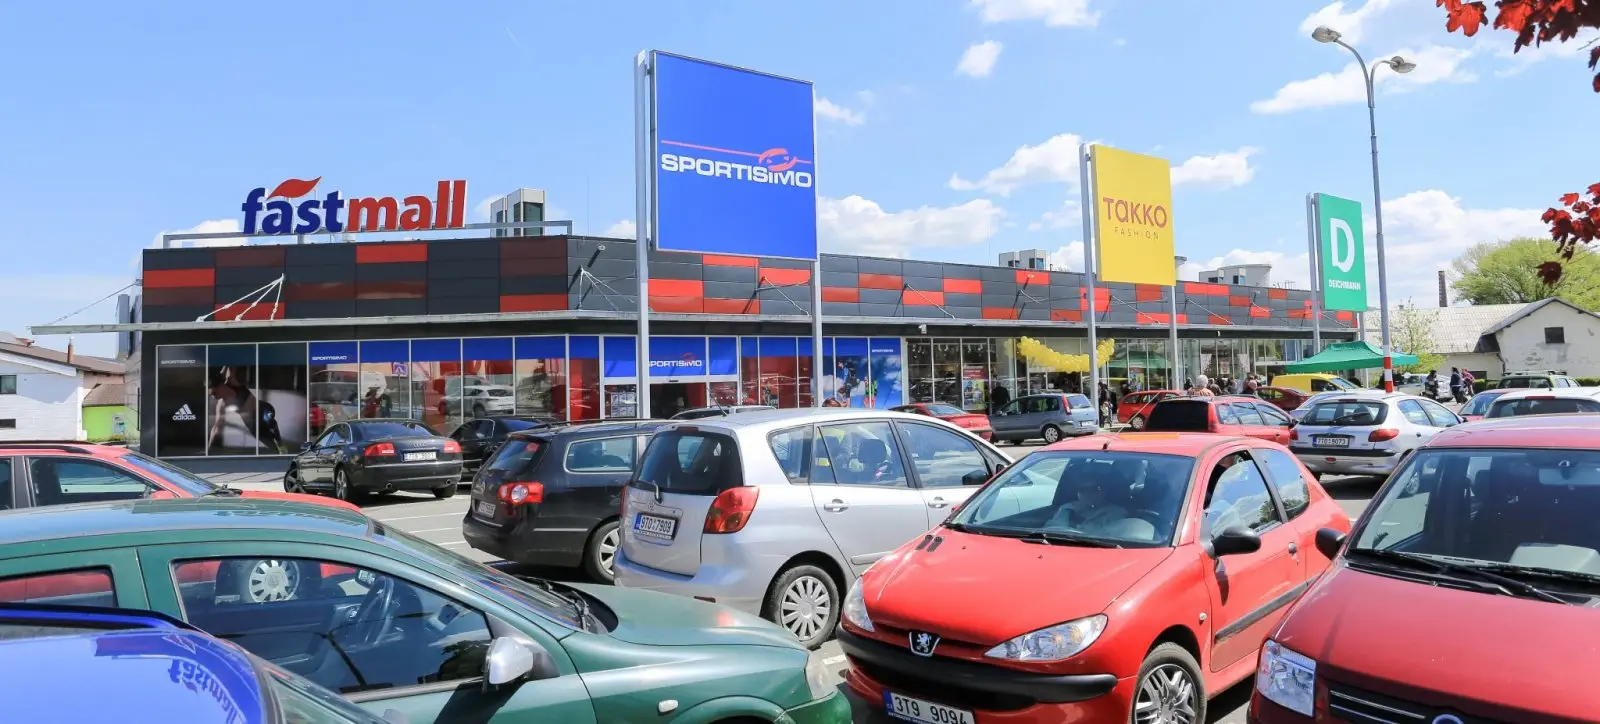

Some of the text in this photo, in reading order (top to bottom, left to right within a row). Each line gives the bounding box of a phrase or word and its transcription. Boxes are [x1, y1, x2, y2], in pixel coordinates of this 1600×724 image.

[661, 153, 813, 188] SPORTISIMO
[242, 180, 468, 235] fastmall
[1114, 226, 1159, 240] FASHION
[1330, 217, 1356, 273] D
[1328, 278, 1361, 290] DEICHMANN
[172, 413, 197, 421] adidas
[894, 696, 921, 717] 3T9
